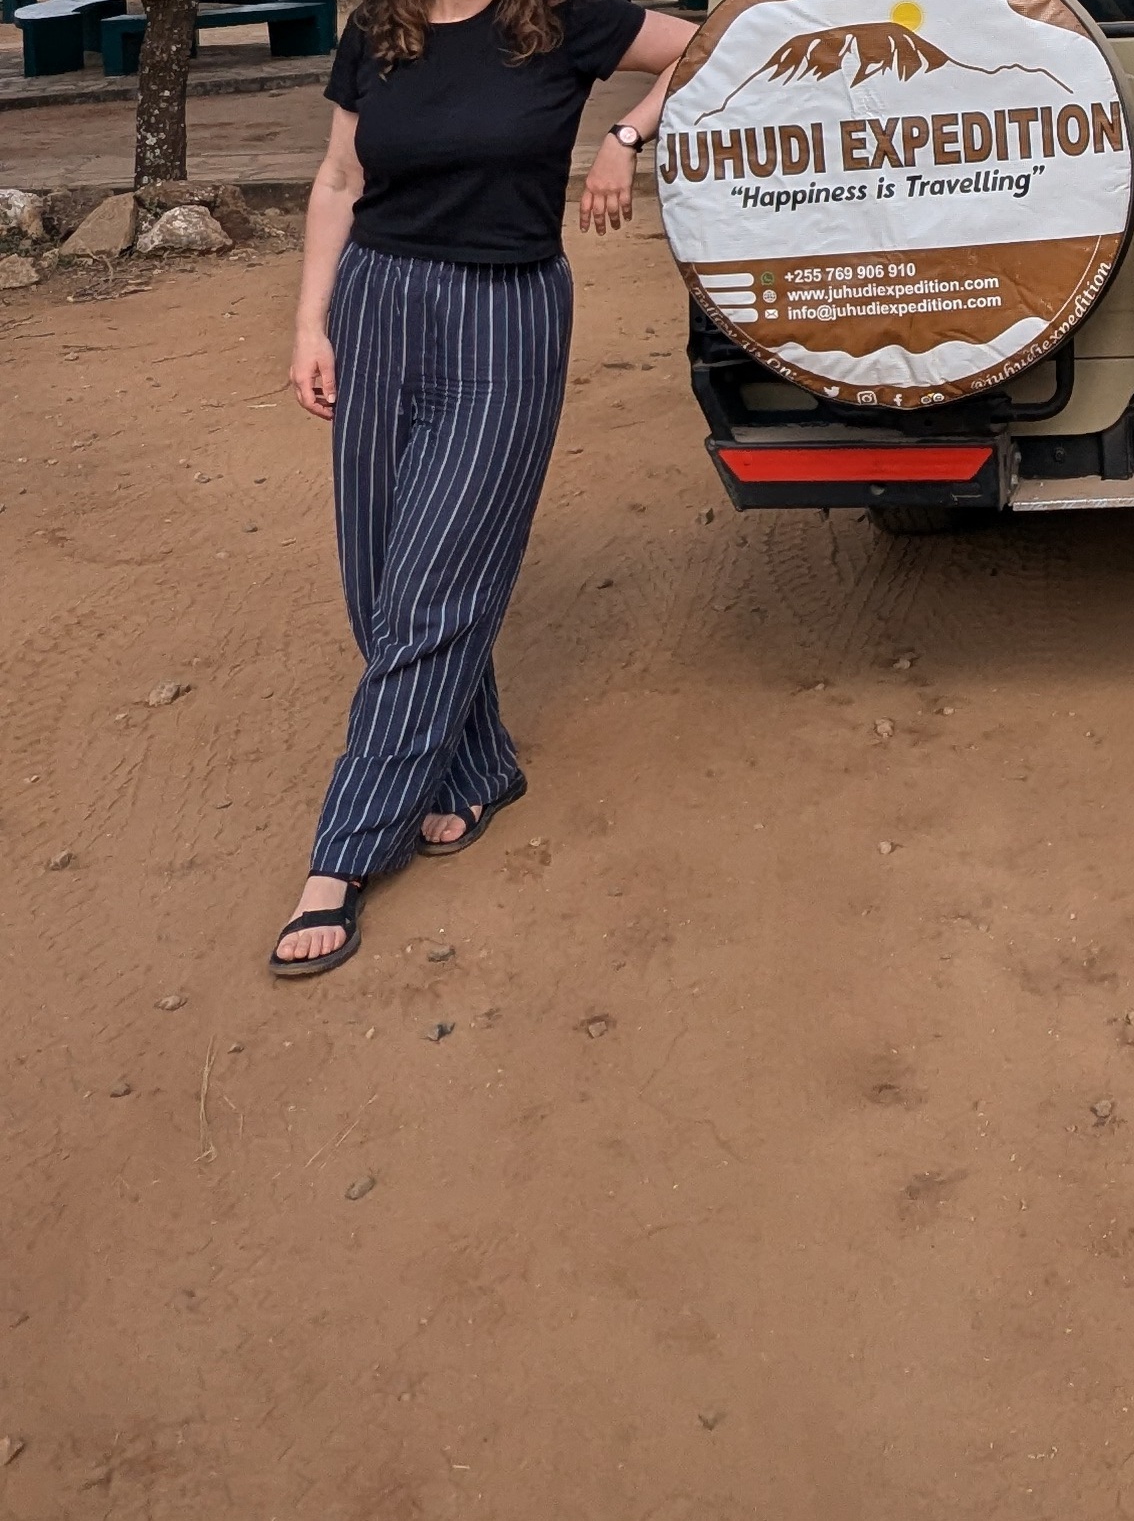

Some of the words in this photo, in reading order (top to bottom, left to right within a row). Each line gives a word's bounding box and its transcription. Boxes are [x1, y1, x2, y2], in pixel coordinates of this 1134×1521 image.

[659, 122, 826, 185] JUHUDI
[841, 101, 1124, 171] EXPEDITION
[731, 185, 867, 212] “Happiness
[876, 177, 895, 199] is
[906, 165, 1045, 199] Travelling”
[784, 268, 821, 283] +255
[825, 267, 854, 281] 769
[857, 265, 884, 279] 906
[887, 263, 916, 277] 910
[787, 276, 999, 304] www.juhudiexpedition.com
[787, 294, 1002, 322] info@juhudiexpedition.com
